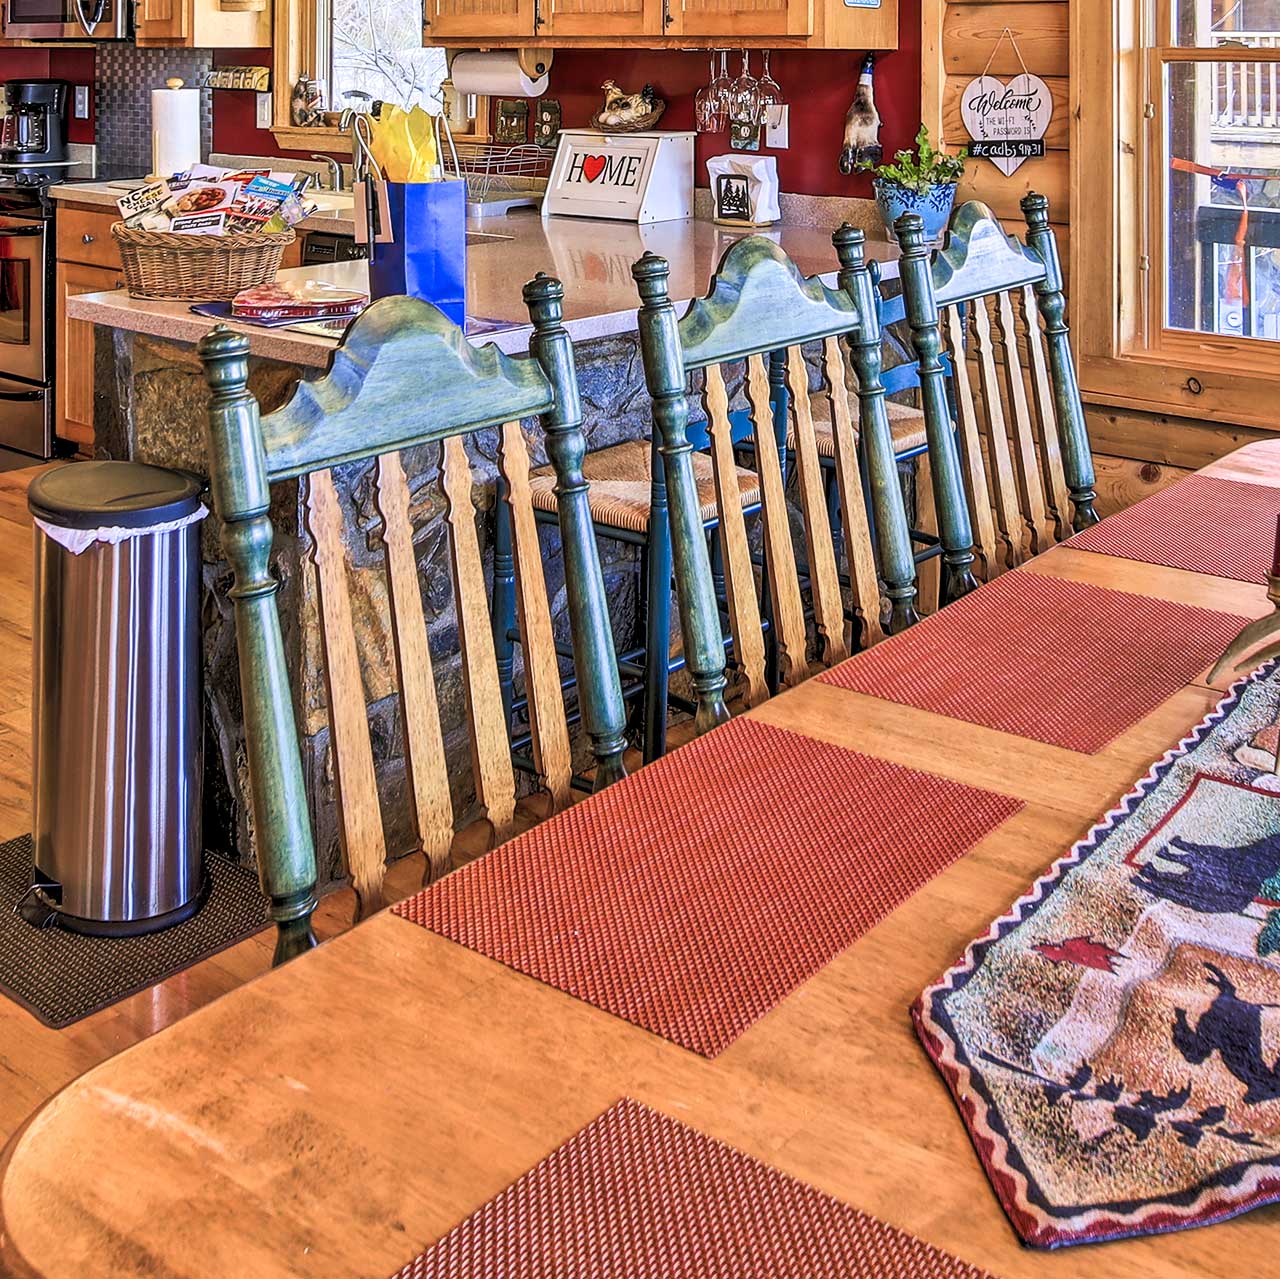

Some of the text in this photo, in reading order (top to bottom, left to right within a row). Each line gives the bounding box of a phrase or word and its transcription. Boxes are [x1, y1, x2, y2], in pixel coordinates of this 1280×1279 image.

[968, 89, 1042, 117] Welcome
[993, 127, 1022, 135] PASSWORD
[127, 188, 164, 210] CHEESE
[133, 198, 161, 212] TRAIL
